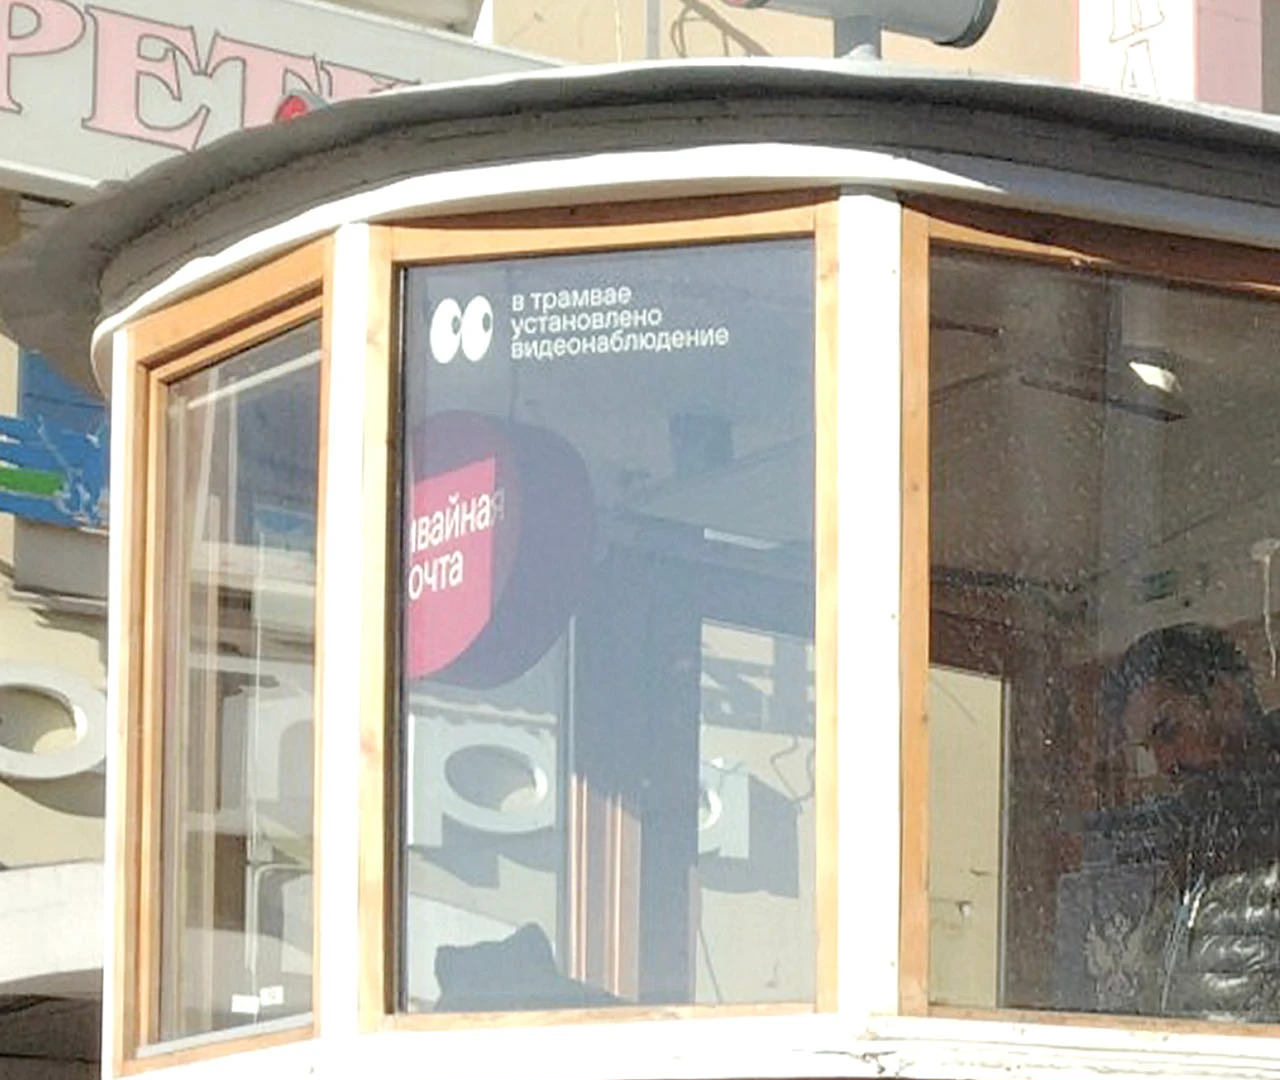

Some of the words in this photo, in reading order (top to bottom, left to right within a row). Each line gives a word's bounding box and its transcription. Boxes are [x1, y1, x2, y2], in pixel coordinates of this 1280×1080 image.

[0, 0, 421, 153] РЕТ
[511, 294, 525, 312] в
[529, 285, 632, 314] трамвае
[510, 307, 663, 341] установлено
[510, 326, 730, 361] видеонаблюдение
[410, 487, 505, 553] вайная
